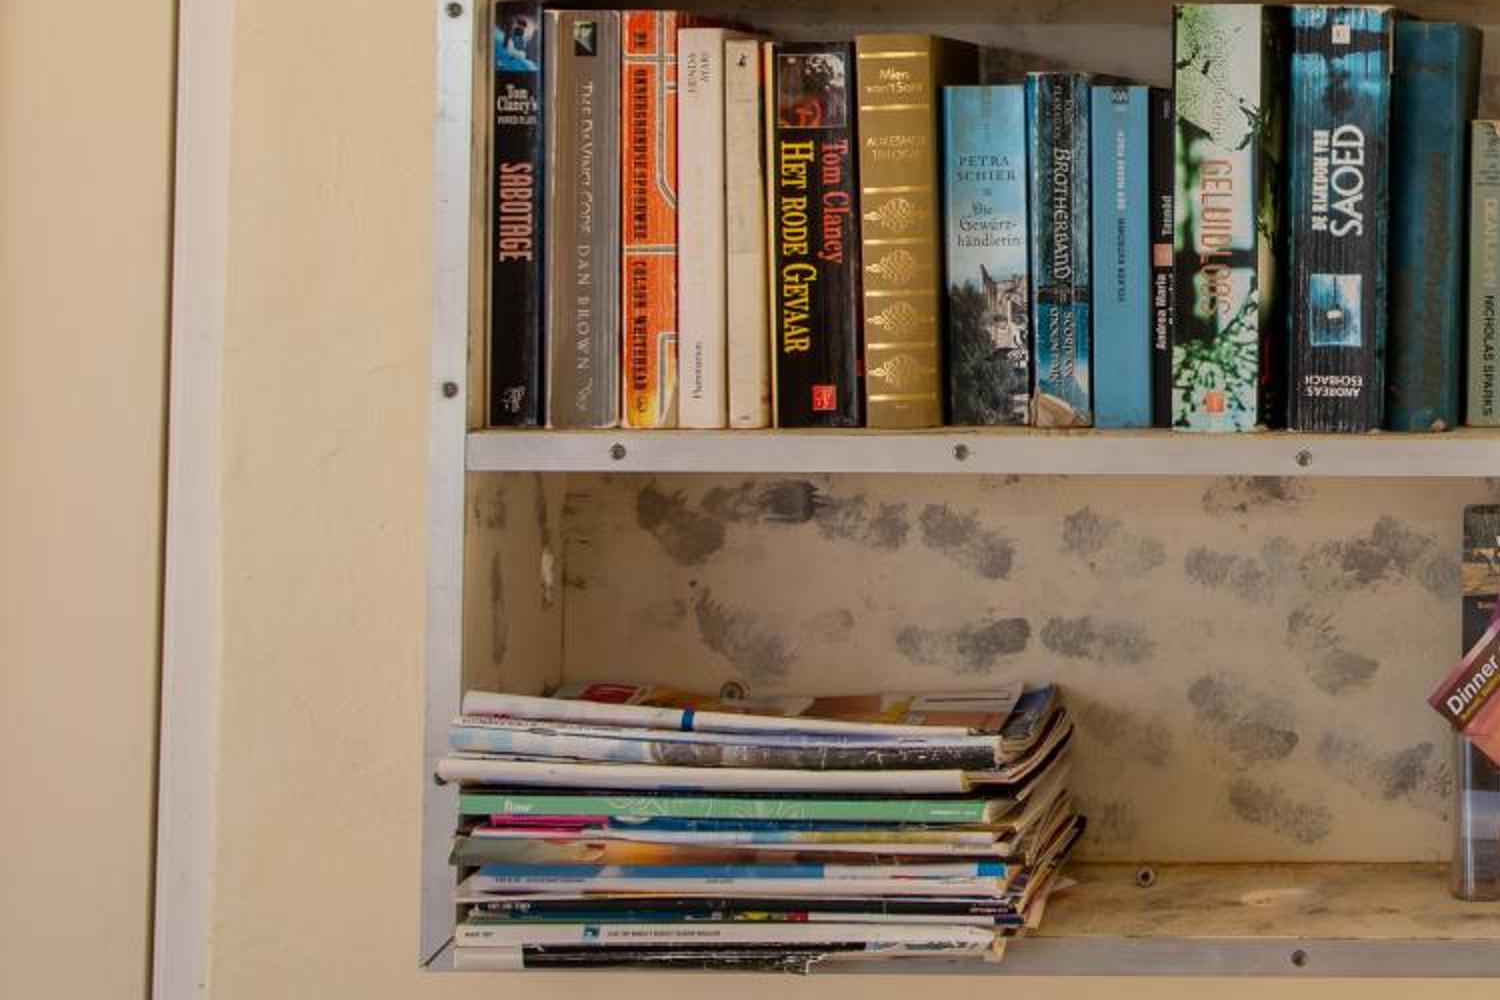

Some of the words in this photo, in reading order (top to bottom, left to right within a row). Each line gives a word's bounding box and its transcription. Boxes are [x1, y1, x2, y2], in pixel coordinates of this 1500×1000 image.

[576, 82, 592, 115] THE
[576, 141, 592, 186] VINCI
[781, 141, 815, 187] HET
[821, 139, 849, 184] Tom
[959, 155, 1010, 168] PETRA
[1312, 129, 1328, 154] VAN
[1312, 156, 1328, 213] RIJKDOM
[1330, 125, 1365, 237] SAOED
[499, 162, 534, 264] SABOTAGE
[576, 189, 592, 235] CODE
[781, 191, 809, 256] RODE
[818, 192, 850, 264] Clancy
[1052, 148, 1073, 280] BROTHERBAND
[1201, 160, 1233, 315] GELUIDLOOS
[575, 245, 591, 285] DAN
[633, 260, 648, 307] COLSON
[783, 262, 817, 354] GEVAAR
[1155, 274, 1167, 307] Maria
[575, 295, 591, 370] BROWN
[1155, 308, 1168, 350] Andrea
[1482, 295, 1496, 361] NICHOLAS
[633, 316, 648, 391] WHITEHEAD
[1304, 374, 1364, 386] ESCHBACH
[1305, 386, 1361, 397] ANDREAS
[1482, 364, 1496, 417] SPARKS
[1445, 658, 1500, 717] Dinner
